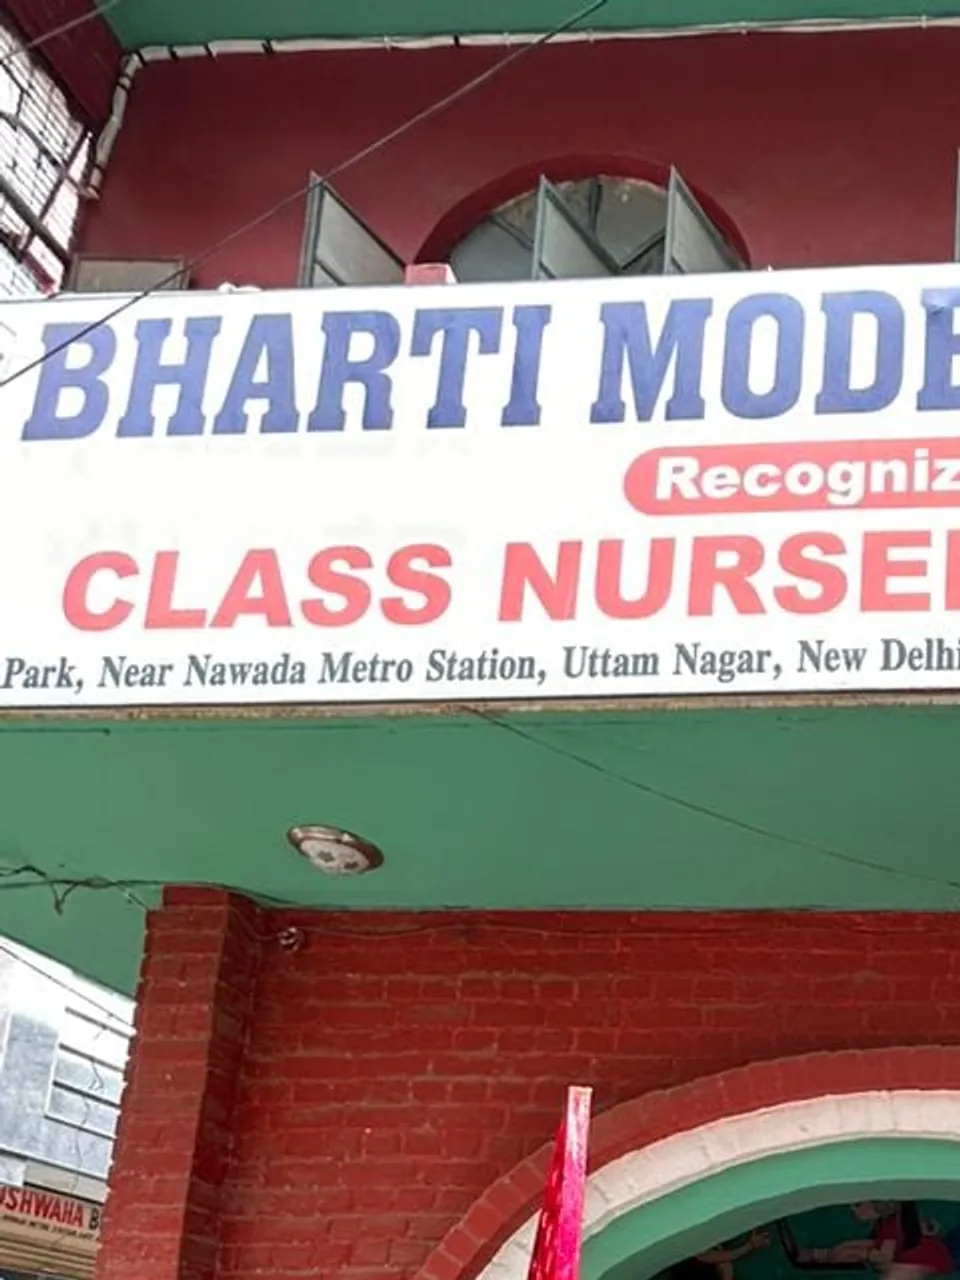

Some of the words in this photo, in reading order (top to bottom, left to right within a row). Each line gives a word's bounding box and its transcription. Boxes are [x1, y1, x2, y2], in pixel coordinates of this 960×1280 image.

[20, 304, 552, 441] BHARTI
[62, 543, 453, 632] CLASS
[0, 656, 84, 695] Park,
[97, 656, 173, 688] Near
[184, 653, 306, 686] Nawada
[319, 650, 413, 684] Metro
[426, 649, 547, 684] Station,
[563, 645, 660, 680] Uttam
[673, 642, 782, 684] Nagar,
[797, 640, 868, 673] New
